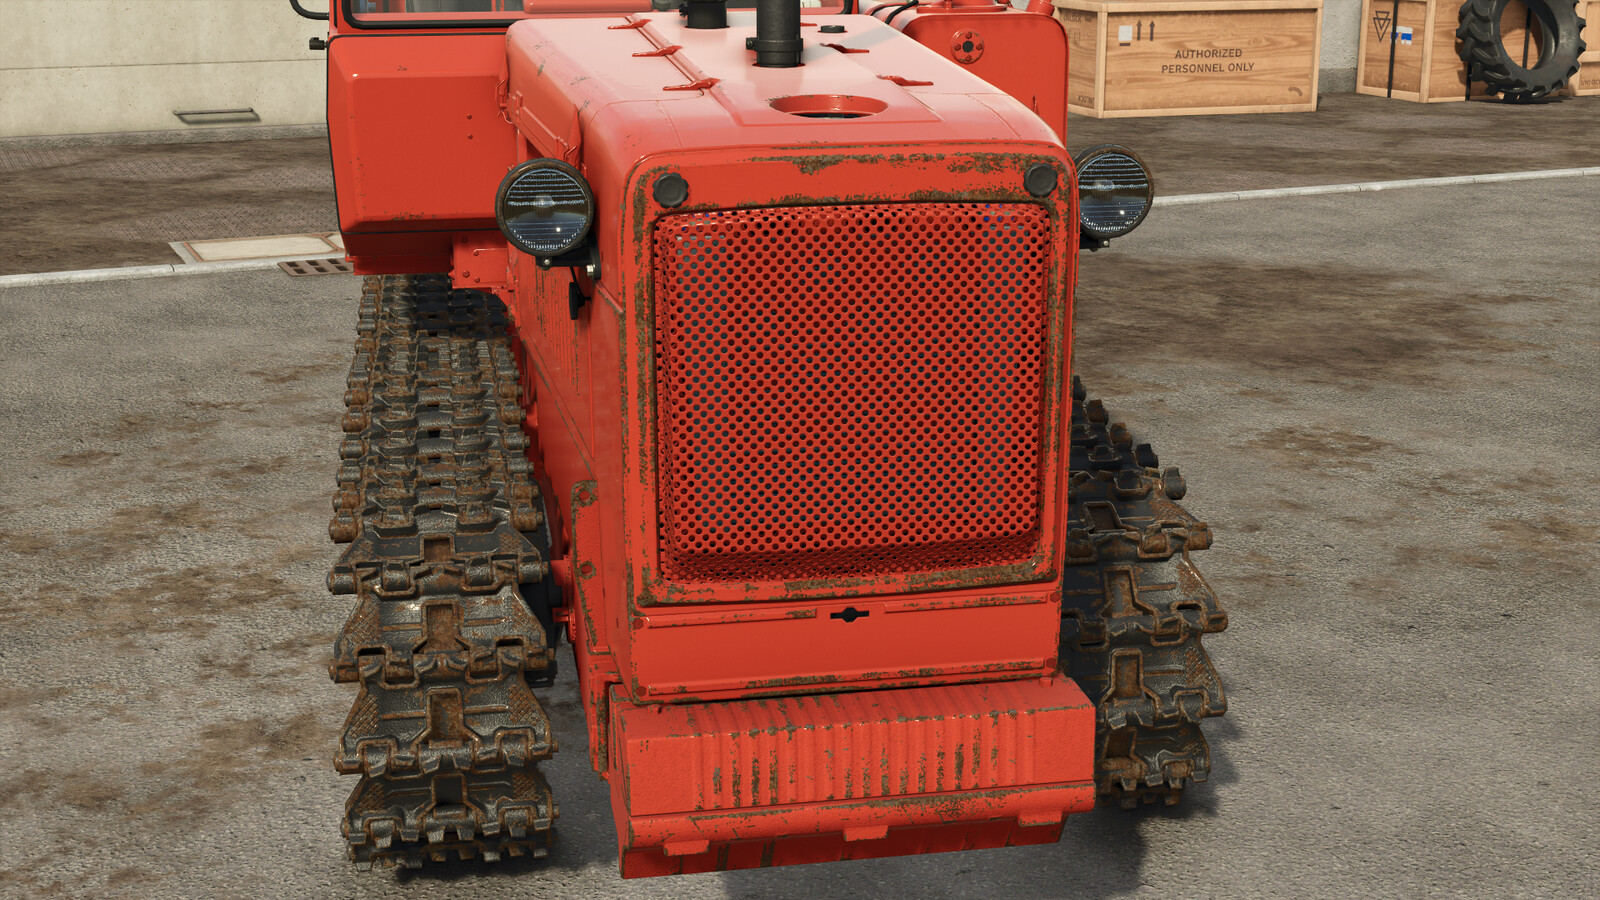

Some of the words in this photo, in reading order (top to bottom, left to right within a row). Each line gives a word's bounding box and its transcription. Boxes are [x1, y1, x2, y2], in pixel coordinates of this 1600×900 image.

[1174, 48, 1243, 59] AUTHORIZED
[1161, 63, 1225, 74] PERSONNEL
[1227, 62, 1255, 72] ONLY
